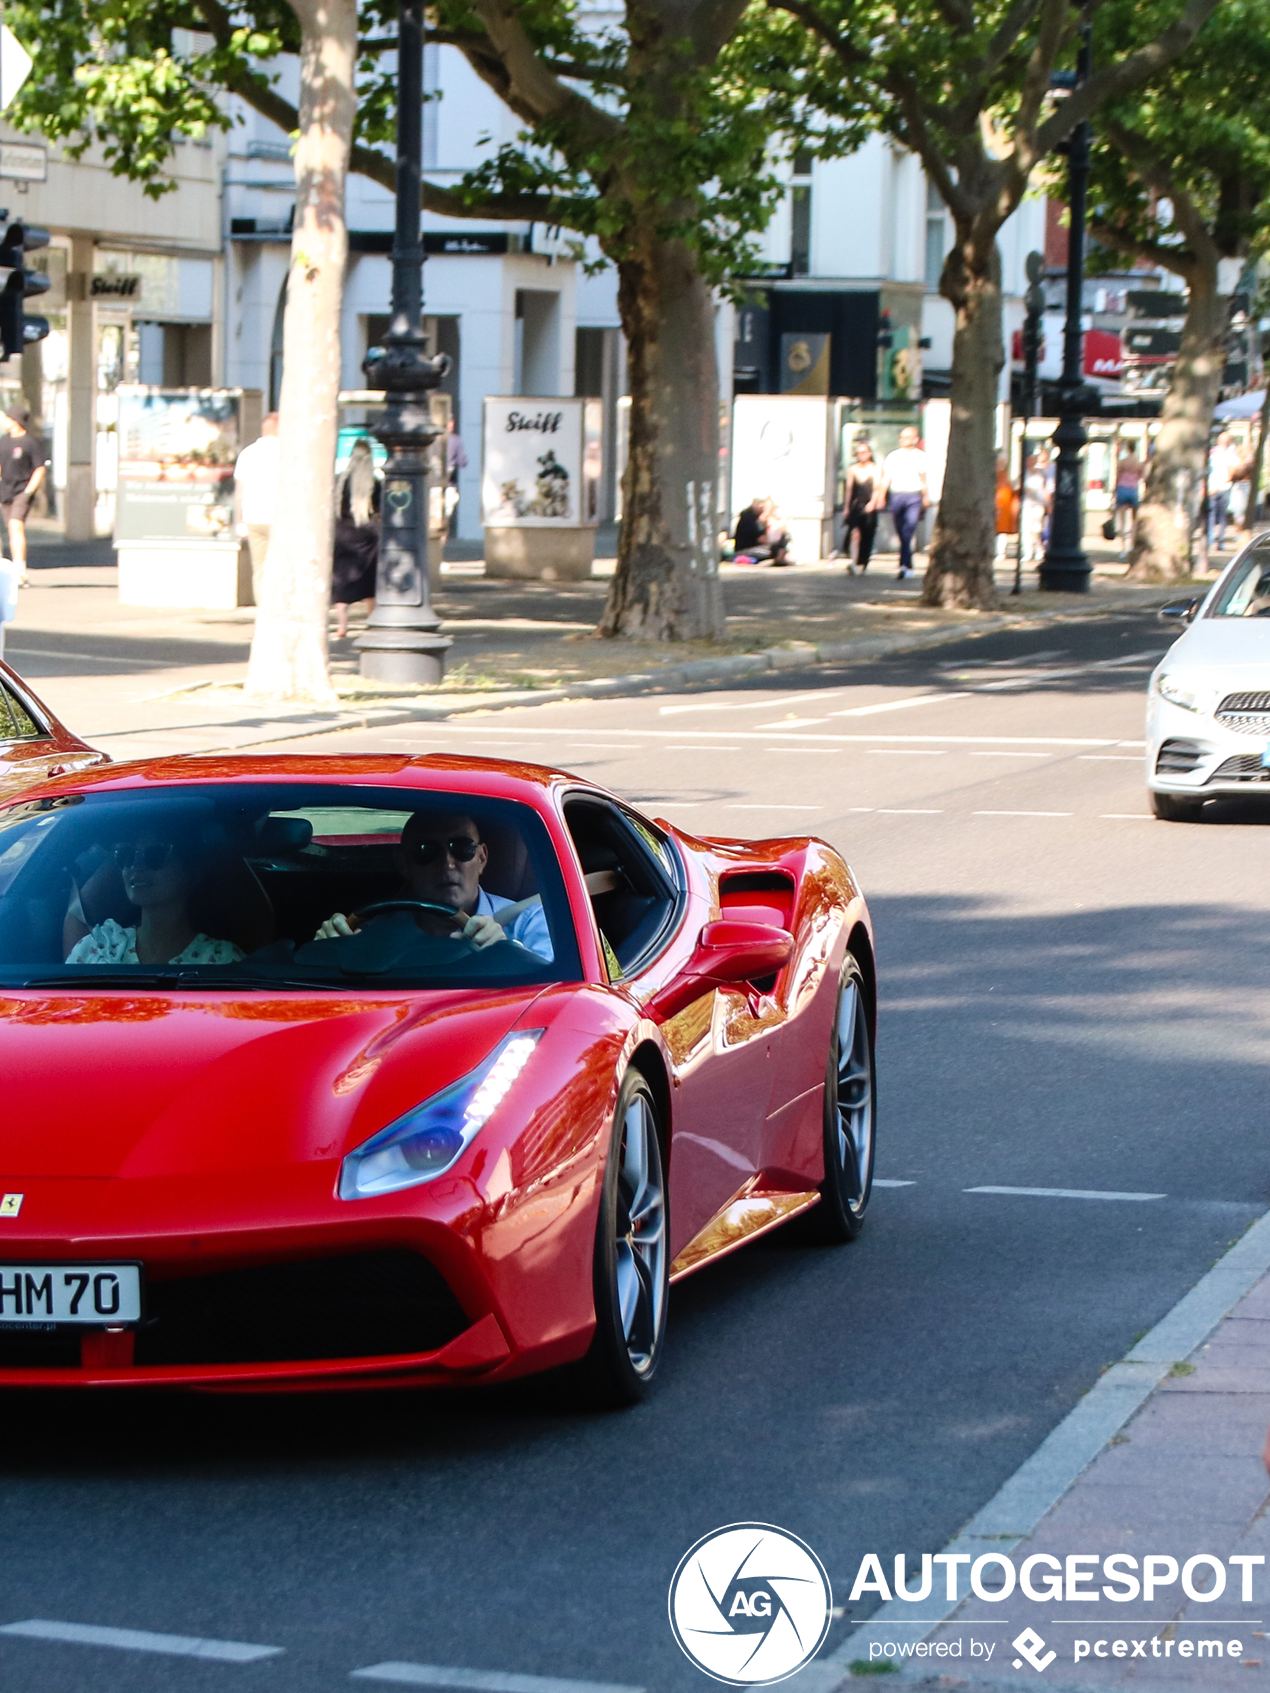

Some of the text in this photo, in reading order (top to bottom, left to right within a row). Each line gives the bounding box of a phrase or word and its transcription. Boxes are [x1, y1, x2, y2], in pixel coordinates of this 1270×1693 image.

[90, 276, 139, 297] Steiff
[505, 410, 564, 433] Steiff
[64, 1272, 120, 1315] 70
